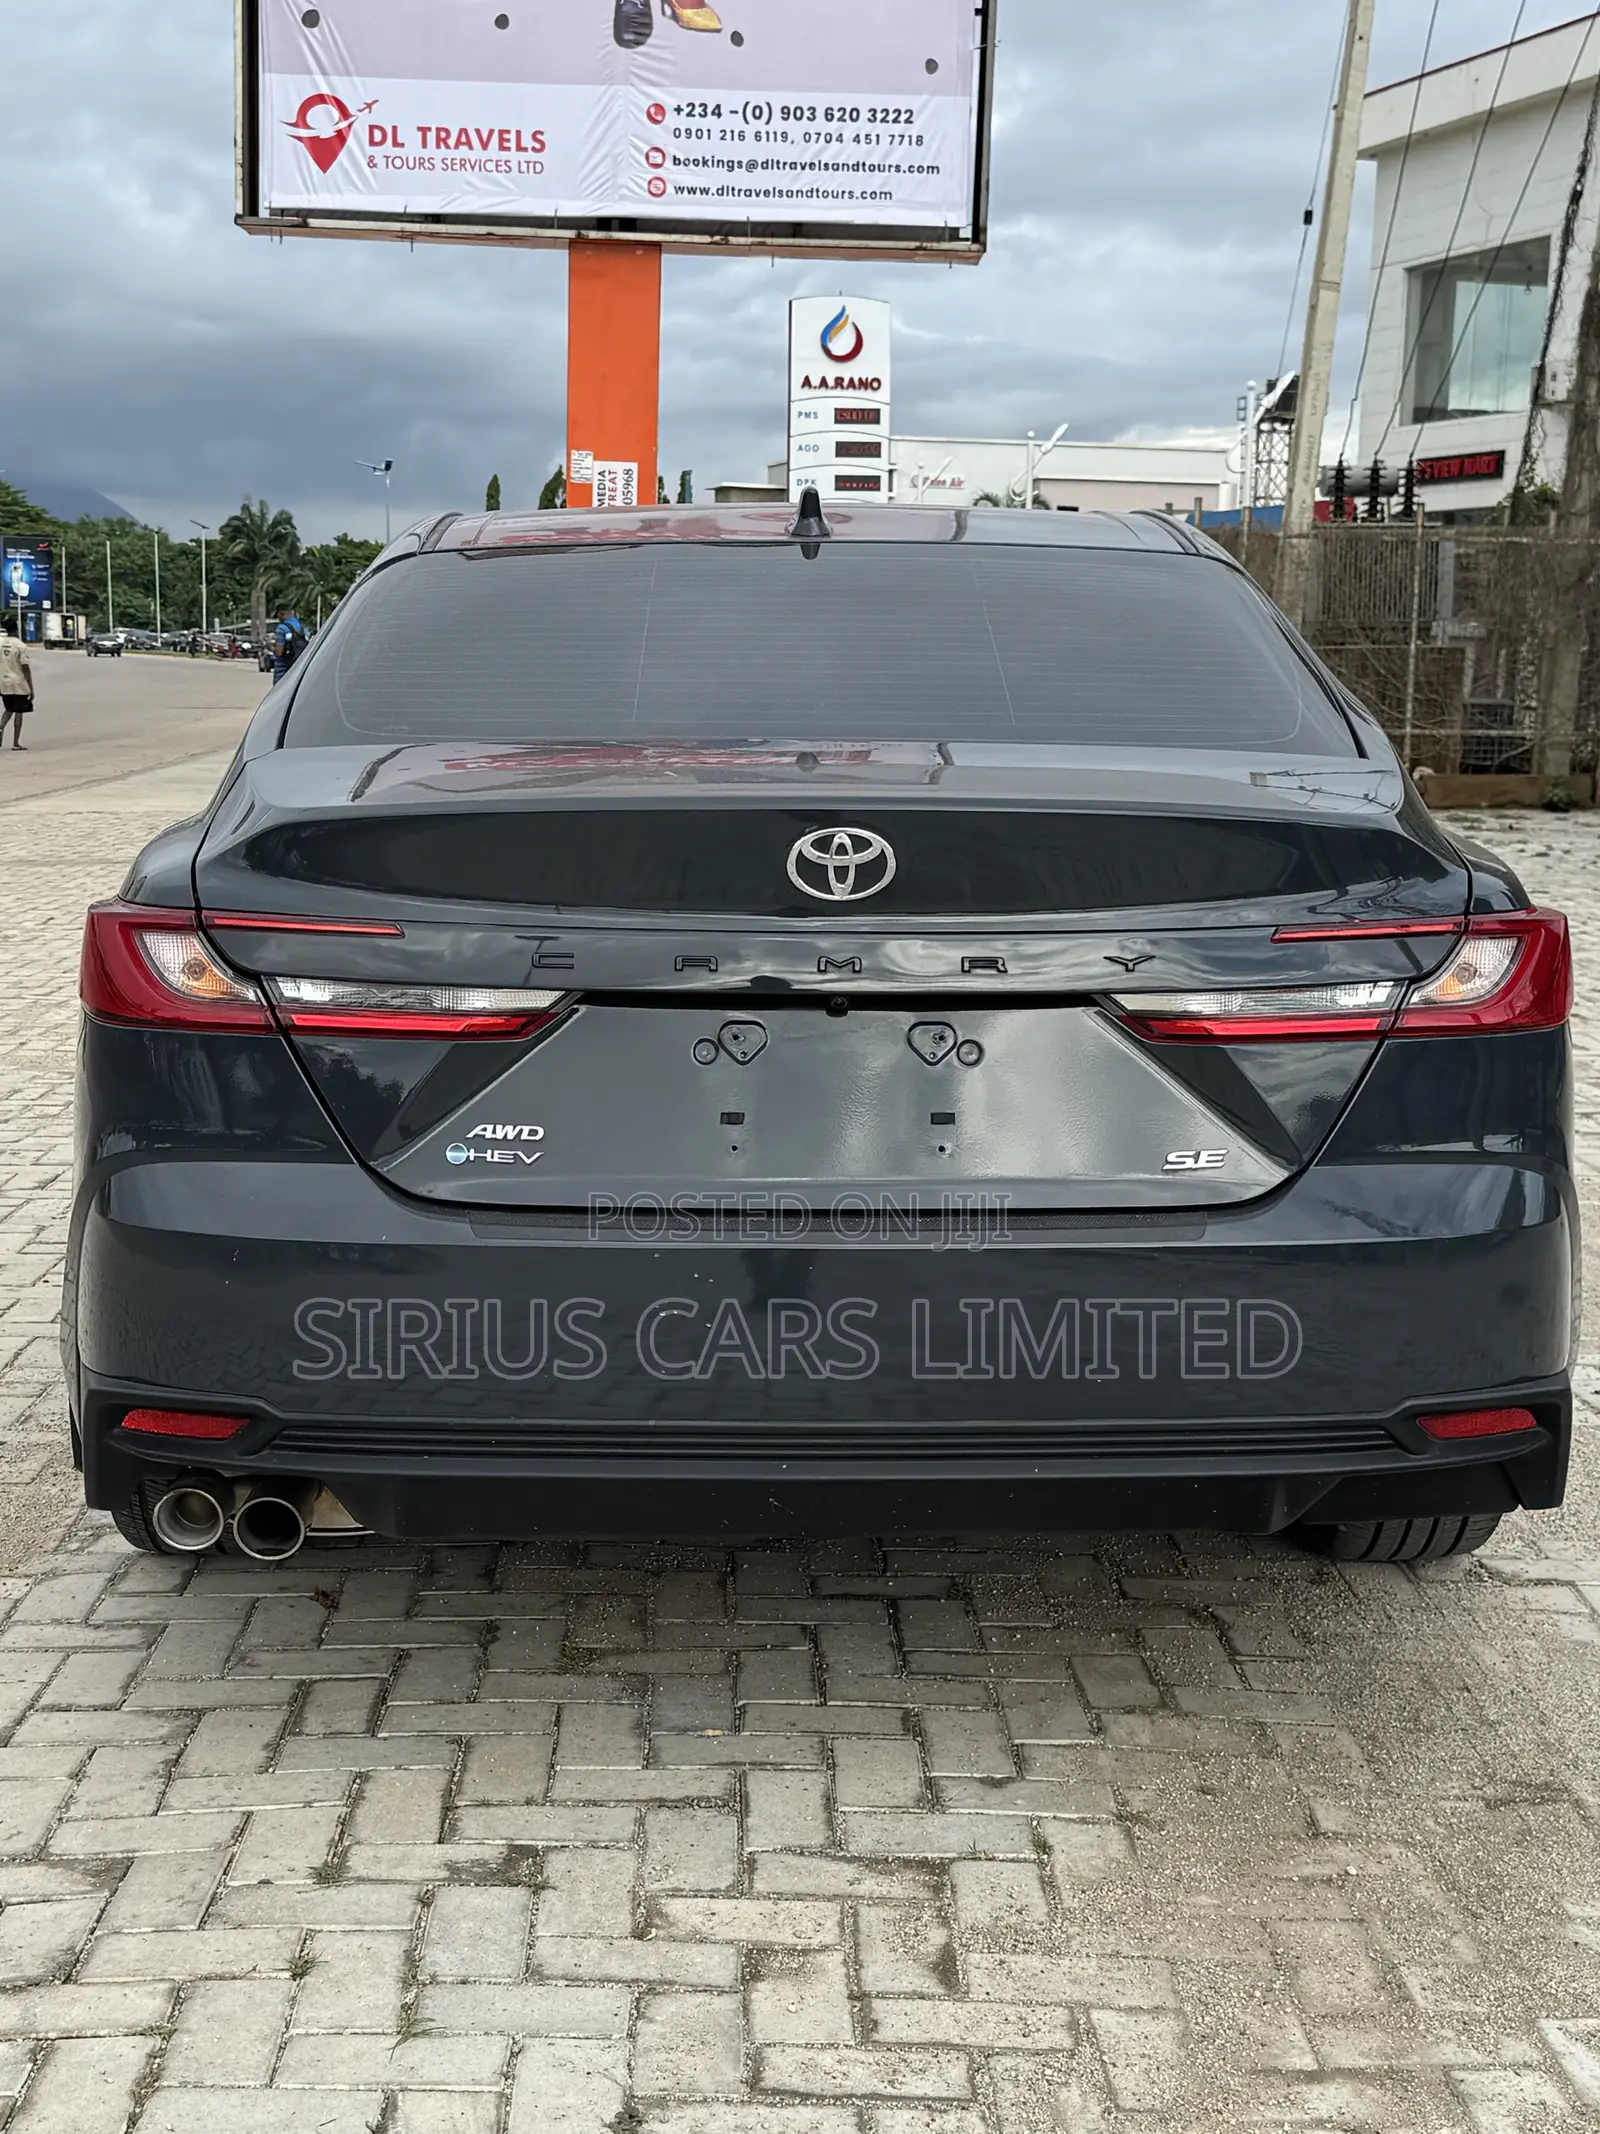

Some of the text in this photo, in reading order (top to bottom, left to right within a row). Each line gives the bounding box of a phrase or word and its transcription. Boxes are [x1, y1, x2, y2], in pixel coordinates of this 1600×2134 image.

[673, 103, 722, 119] +234
[780, 105, 817, 121] 903
[824, 107, 860, 122] 620
[867, 108, 914, 124] 3222
[368, 124, 546, 153] DL TRAVELS
[673, 127, 924, 147] 0901 216 6119, 0704 451 7718
[367, 154, 544, 175] & TOURS SERVICES LTD
[673, 154, 940, 175] bookings@dltravelsandtours.com
[674, 183, 893, 200] www.dltravelsandtours.com
[801, 375, 882, 391] A.A.RANO
[797, 411, 818, 419] PMS
[797, 444, 819, 452] AGO
[621, 468, 634, 505] 05968
[797, 478, 817, 486] DPK
[531, 952, 1156, 973] CAMRY
[466, 1124, 545, 1140] AWD
[468, 1148, 544, 1164] HEV
[1162, 1149, 1229, 1170] SE
